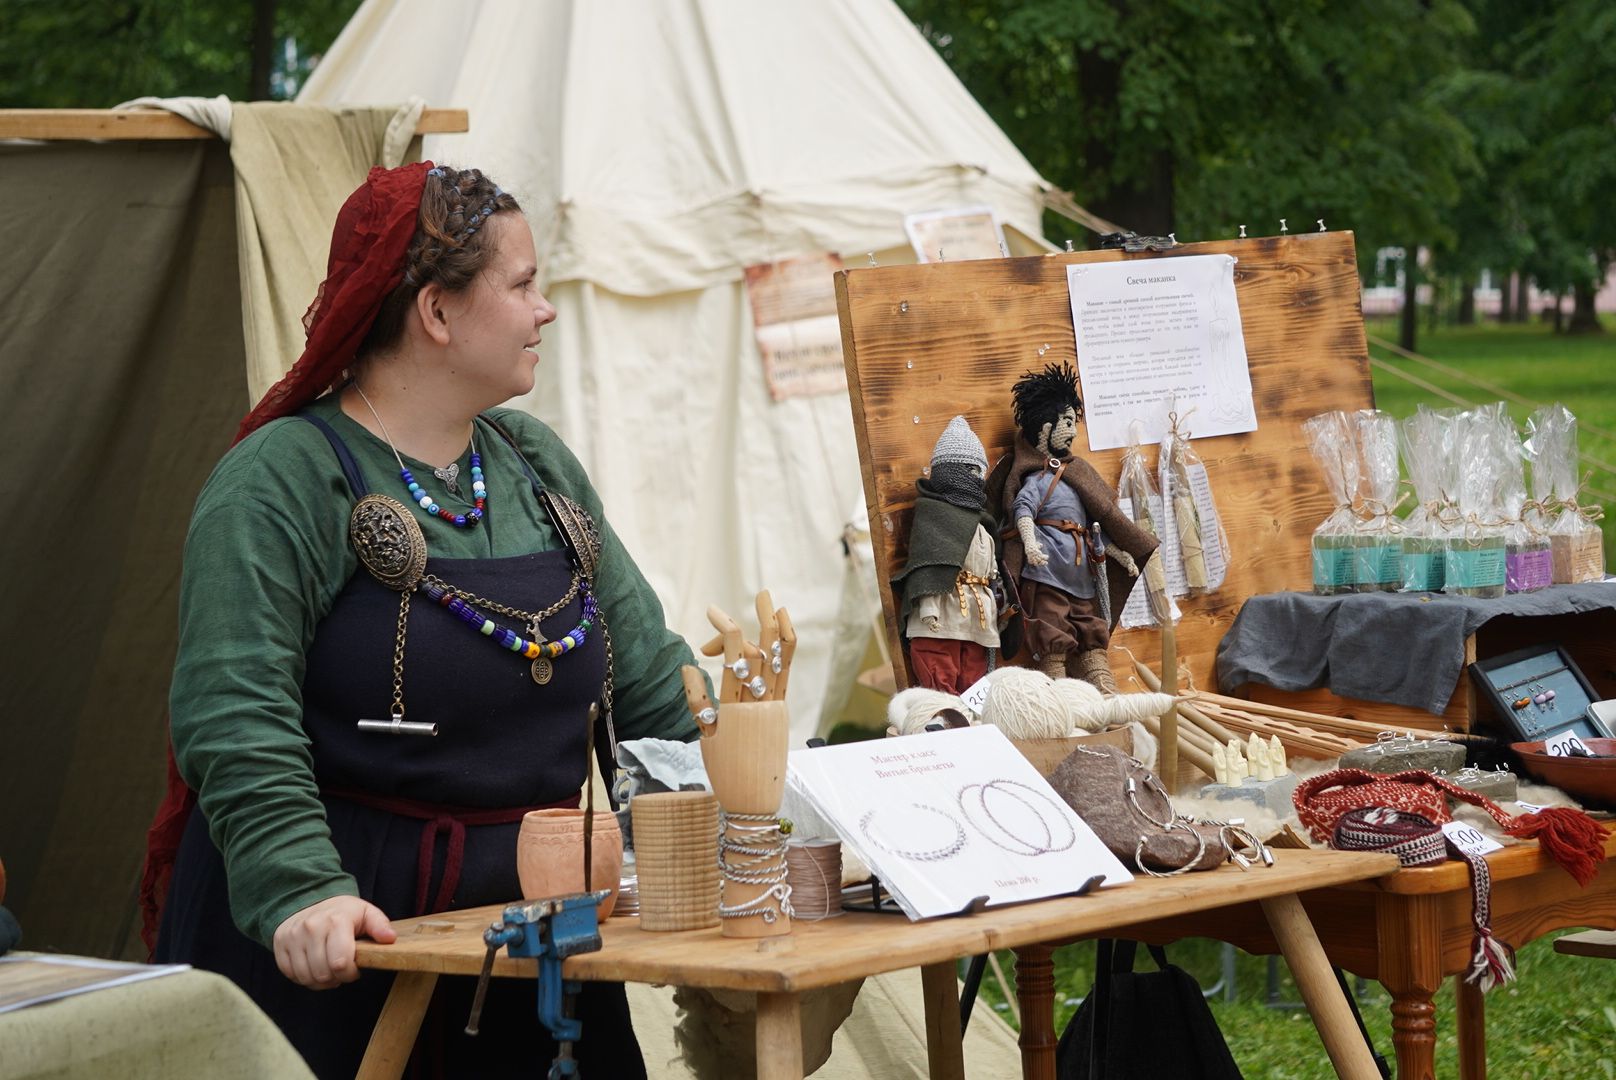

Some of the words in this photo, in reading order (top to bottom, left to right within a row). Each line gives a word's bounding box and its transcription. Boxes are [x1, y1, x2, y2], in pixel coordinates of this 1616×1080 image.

[1126, 275, 1148, 286] Свеча
[1552, 737, 1584, 757] 200
[870, 755, 909, 763] Мастер
[910, 750, 937, 759] класс
[875, 766, 909, 779] Витые
[908, 761, 956, 776] браслеты
[1448, 828, 1484, 846] 500
[993, 879, 1018, 888] Цена
